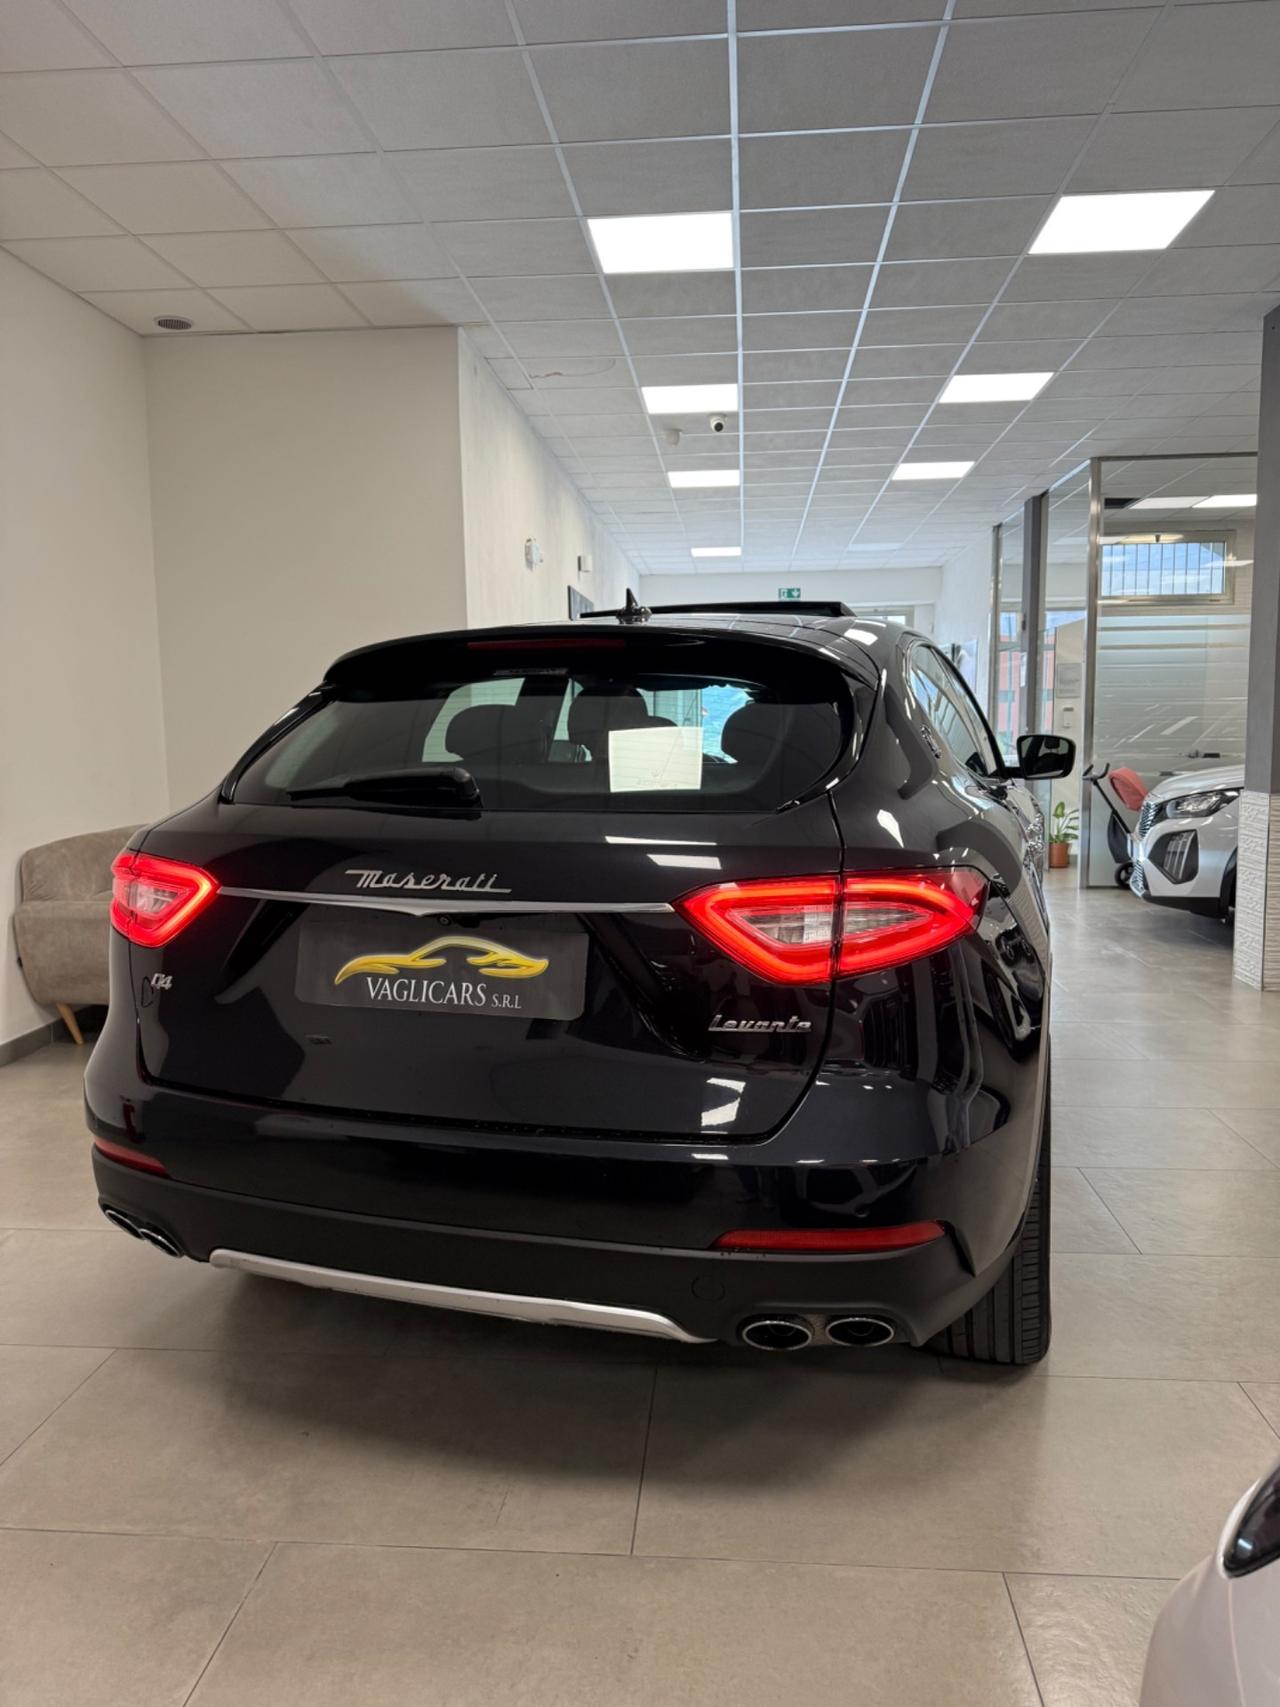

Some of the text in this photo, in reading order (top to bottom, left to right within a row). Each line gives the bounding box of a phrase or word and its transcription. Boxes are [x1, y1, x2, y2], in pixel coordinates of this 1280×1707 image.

[345, 869, 512, 894] Maserati
[366, 976, 487, 1007] VAGLICARS
[708, 1014, 812, 1033] Levante
